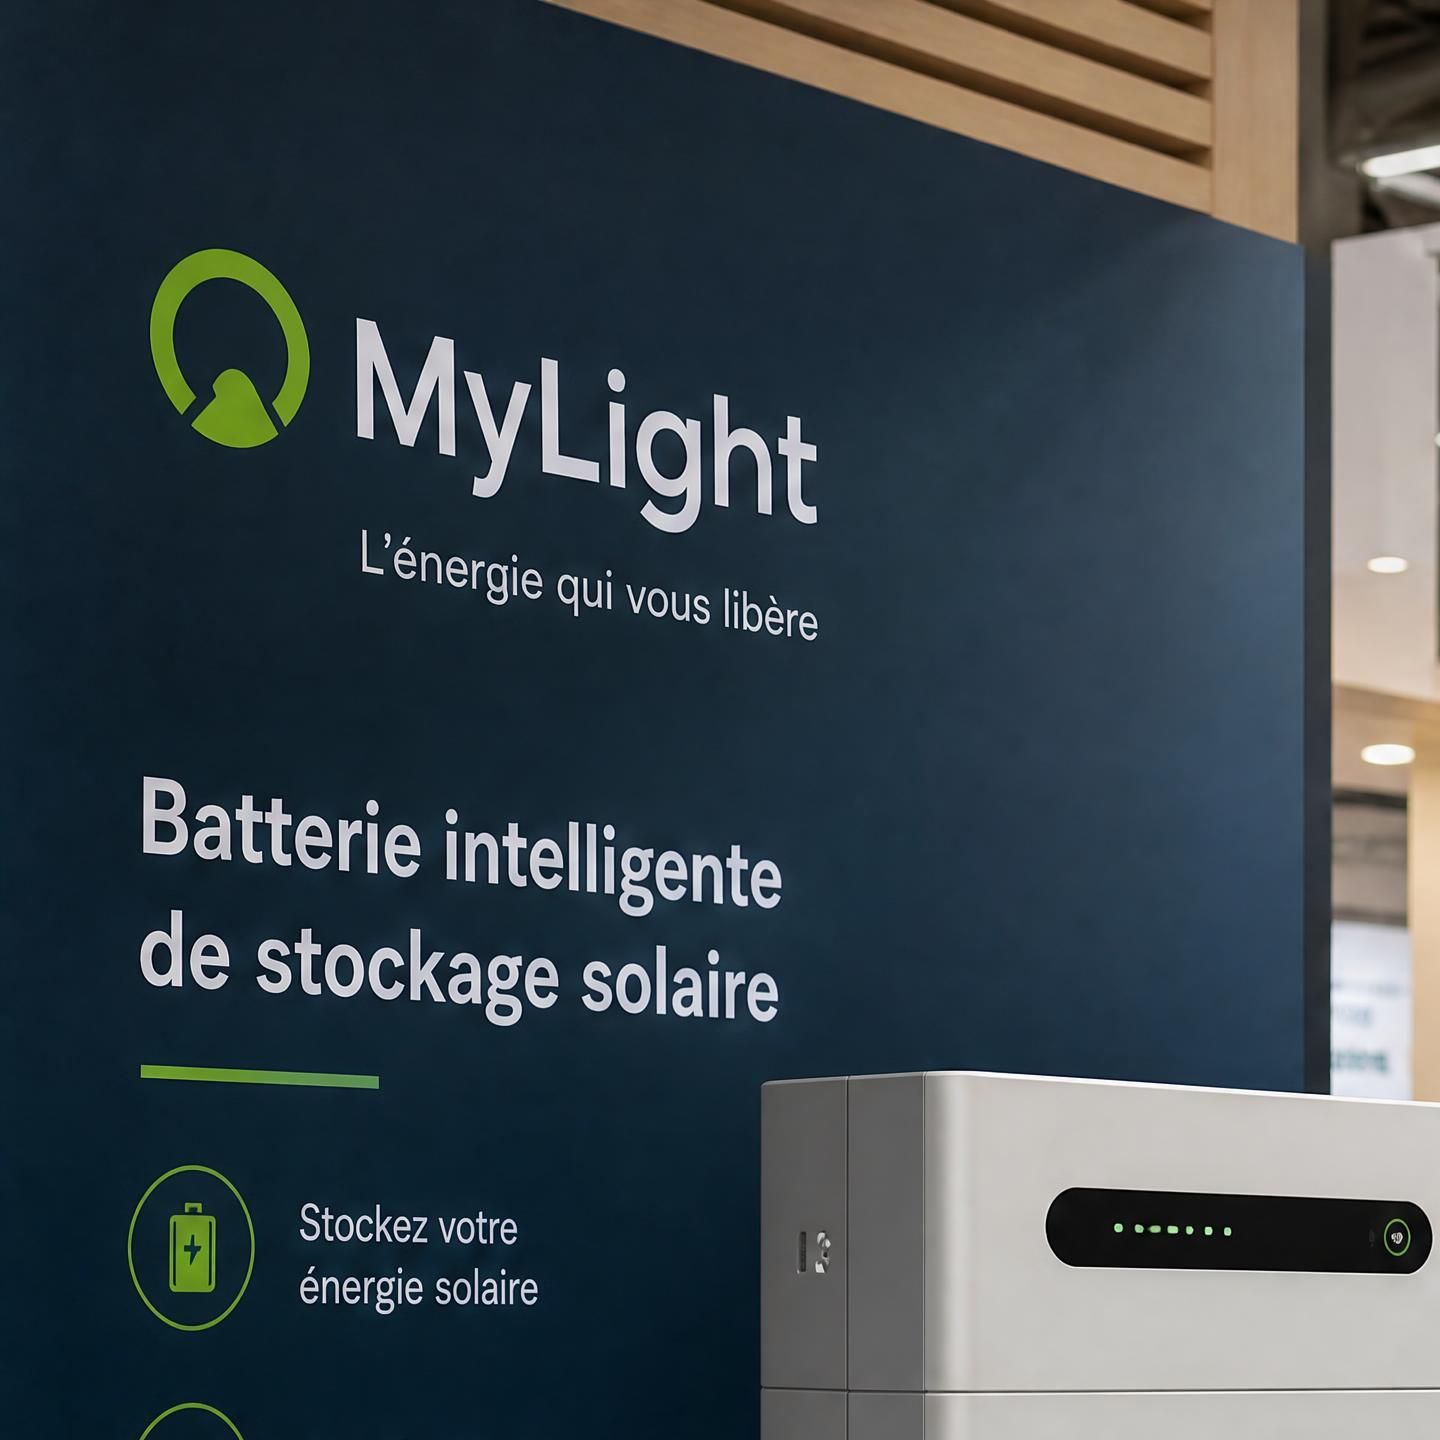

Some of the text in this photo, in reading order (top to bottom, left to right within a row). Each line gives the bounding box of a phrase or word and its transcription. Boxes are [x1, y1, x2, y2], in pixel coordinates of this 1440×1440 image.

[355, 317, 818, 533] MyLight
[558, 570, 612, 616] qui
[626, 585, 710, 624] vous
[725, 588, 818, 640] libère
[143, 776, 781, 916] Batterie intelligente
[140, 910, 778, 1026] de stockage solaire
[300, 1203, 517, 1244] Stockez votre
[300, 1266, 538, 1314] énergie solaire
